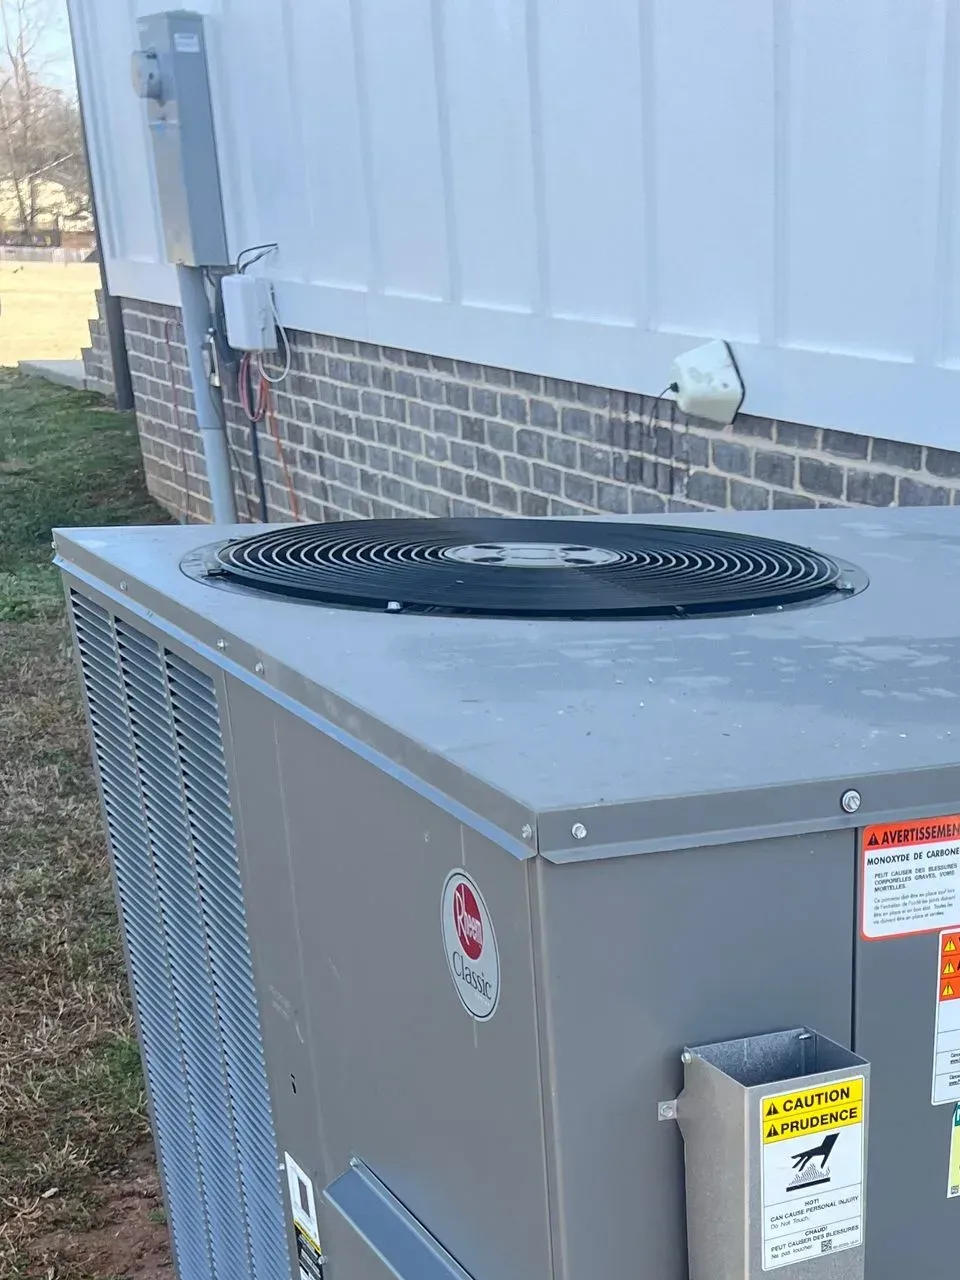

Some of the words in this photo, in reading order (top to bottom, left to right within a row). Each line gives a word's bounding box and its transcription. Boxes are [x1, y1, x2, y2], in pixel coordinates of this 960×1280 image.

[867, 853, 910, 865] MONOXYDE
[914, 852, 922, 860] DE
[927, 847, 959, 858] CARBONE
[453, 951, 491, 1000] Classic
[783, 1087, 850, 1111] CAUTION
[781, 1107, 858, 1134] PRUDENCE
[771, 1214, 783, 1222] CAN
[785, 1209, 804, 1219] CAUSE
[806, 1201, 836, 1213] PERSONAL
[838, 1195, 858, 1205] INJURY
[771, 1244, 786, 1252] PEUT
[788, 1237, 811, 1248] CAUSER
[826, 1225, 858, 1238] BLESSURES
[805, 1226, 827, 1236] CHAUD!
